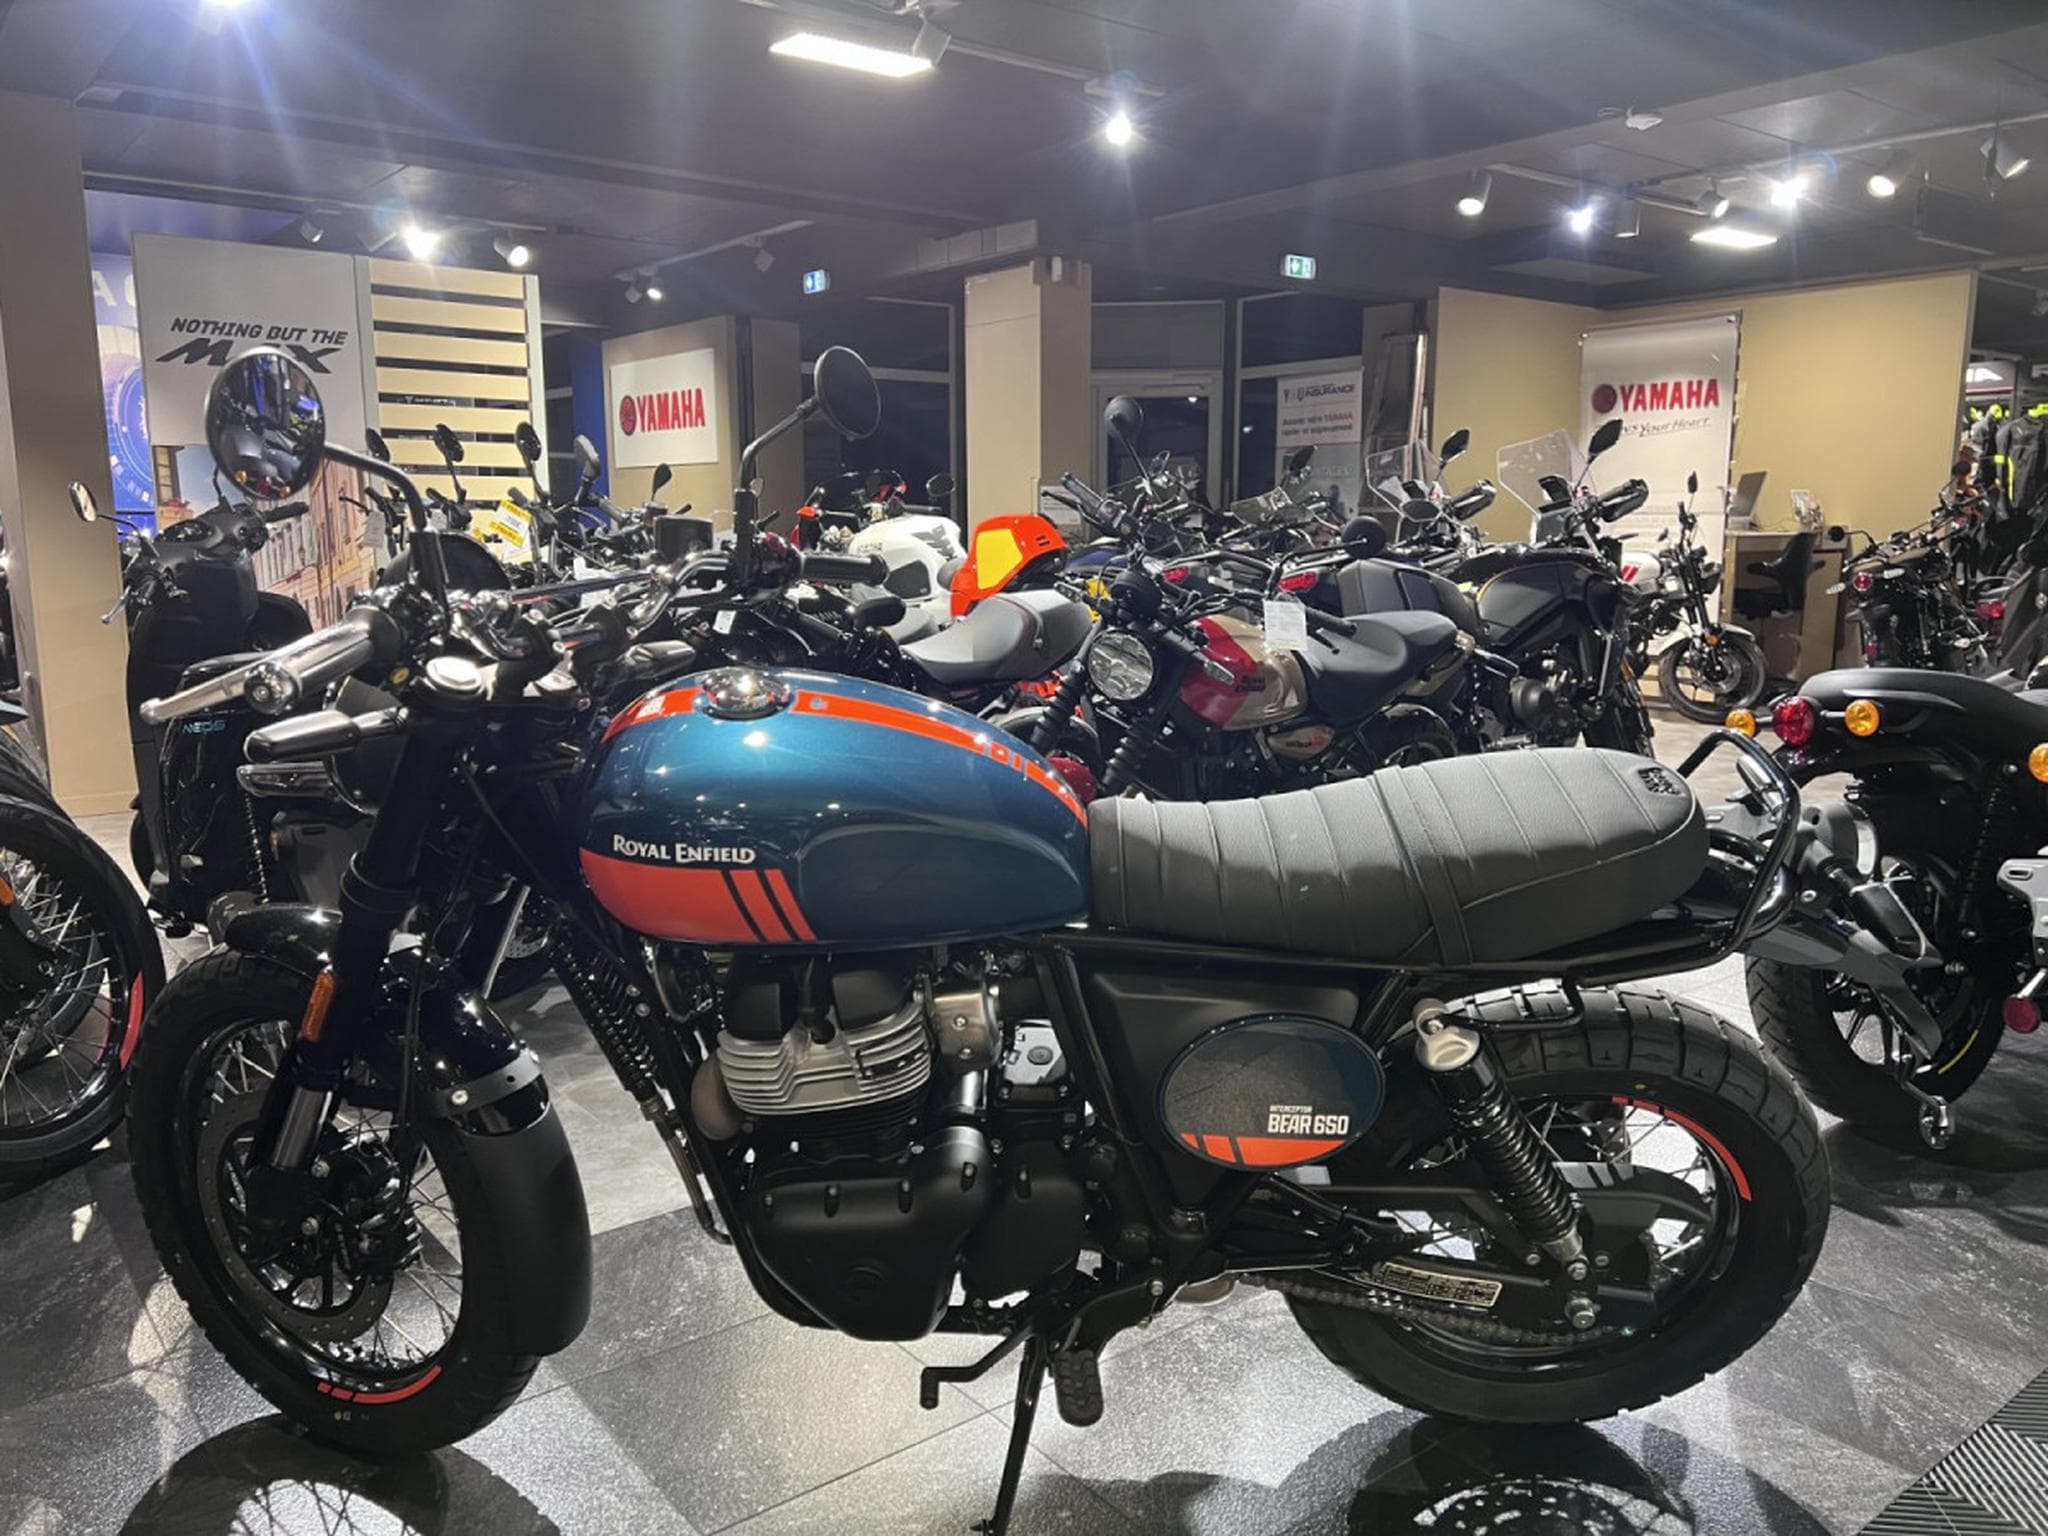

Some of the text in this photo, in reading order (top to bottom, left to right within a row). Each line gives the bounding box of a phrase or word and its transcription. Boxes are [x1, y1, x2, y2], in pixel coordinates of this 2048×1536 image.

[170, 317, 349, 345] NOTHING BUT THE
[155, 338, 342, 374] MX
[636, 387, 706, 433] YAMAHA
[1619, 378, 1720, 413] YAMAHA
[613, 834, 756, 864] ROYAL ENFIELD
[1267, 1113, 1350, 1135] BEAR 650
